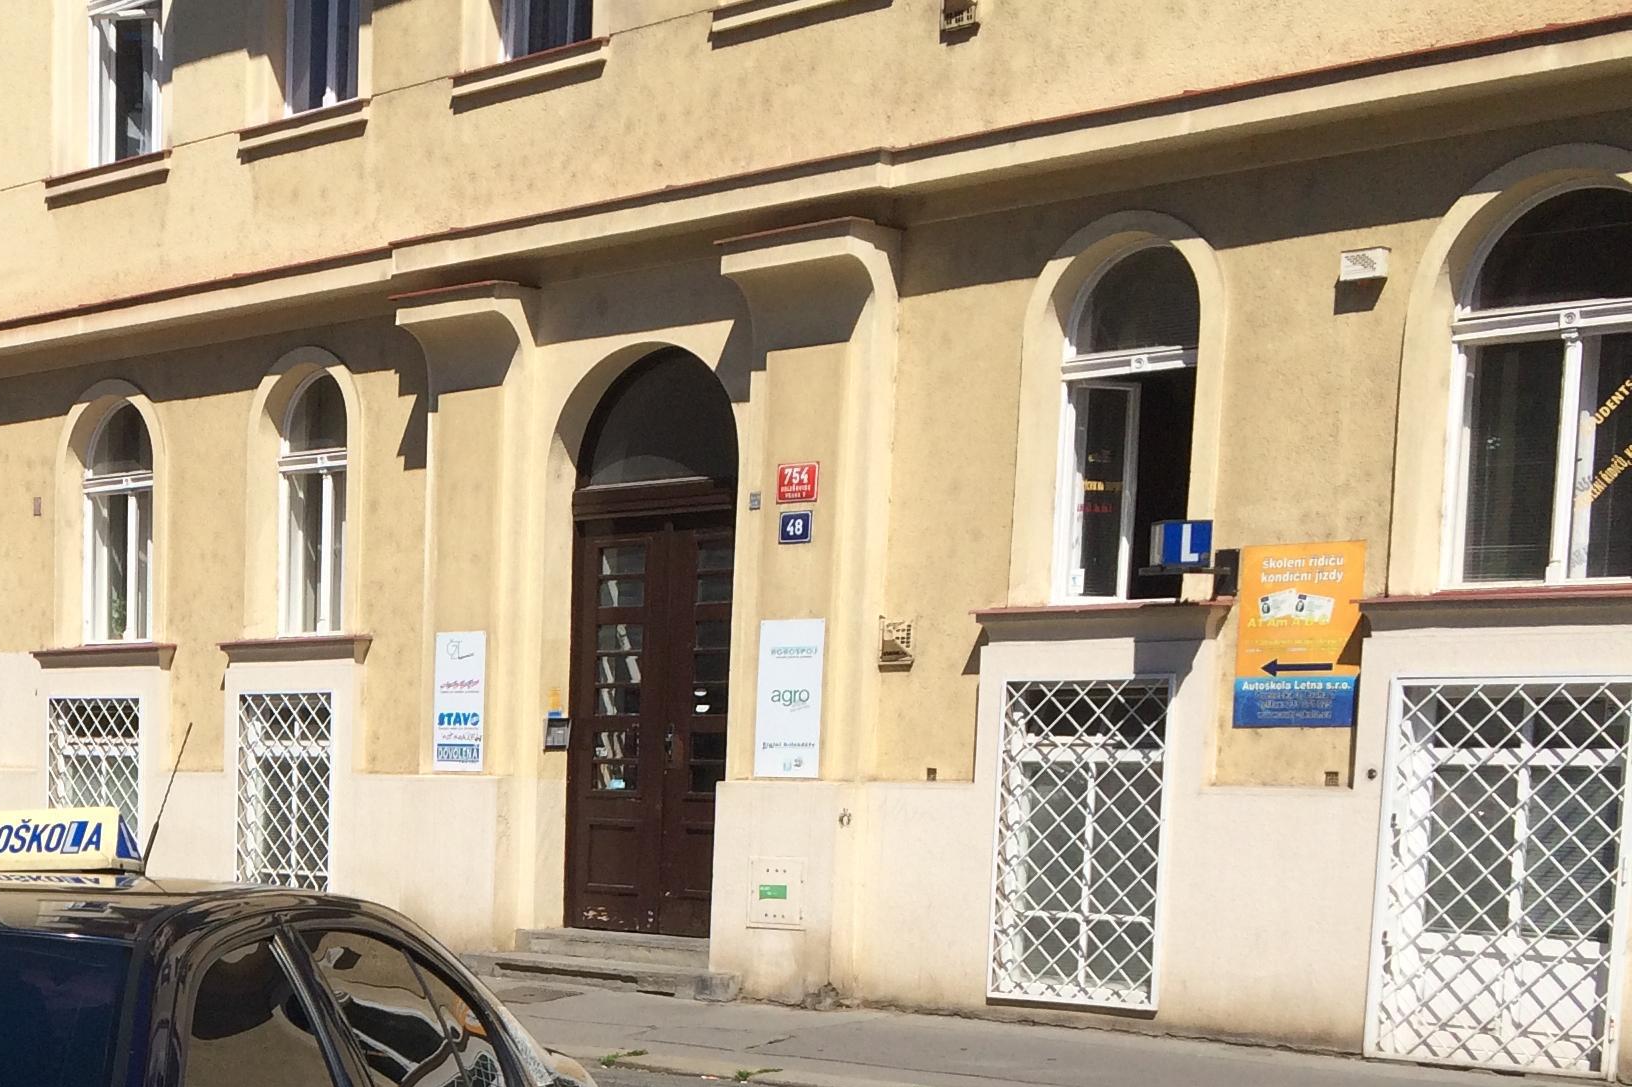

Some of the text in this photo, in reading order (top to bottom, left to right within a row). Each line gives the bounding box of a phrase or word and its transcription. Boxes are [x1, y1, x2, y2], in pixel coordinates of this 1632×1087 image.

[783, 466, 810, 485] 754
[786, 518, 804, 536] 48
[1180, 523, 1200, 563] L
[1325, 681, 1352, 690] s.r.o.
[770, 688, 811, 707] agro
[437, 744, 480, 760] DOVOLENÁ
